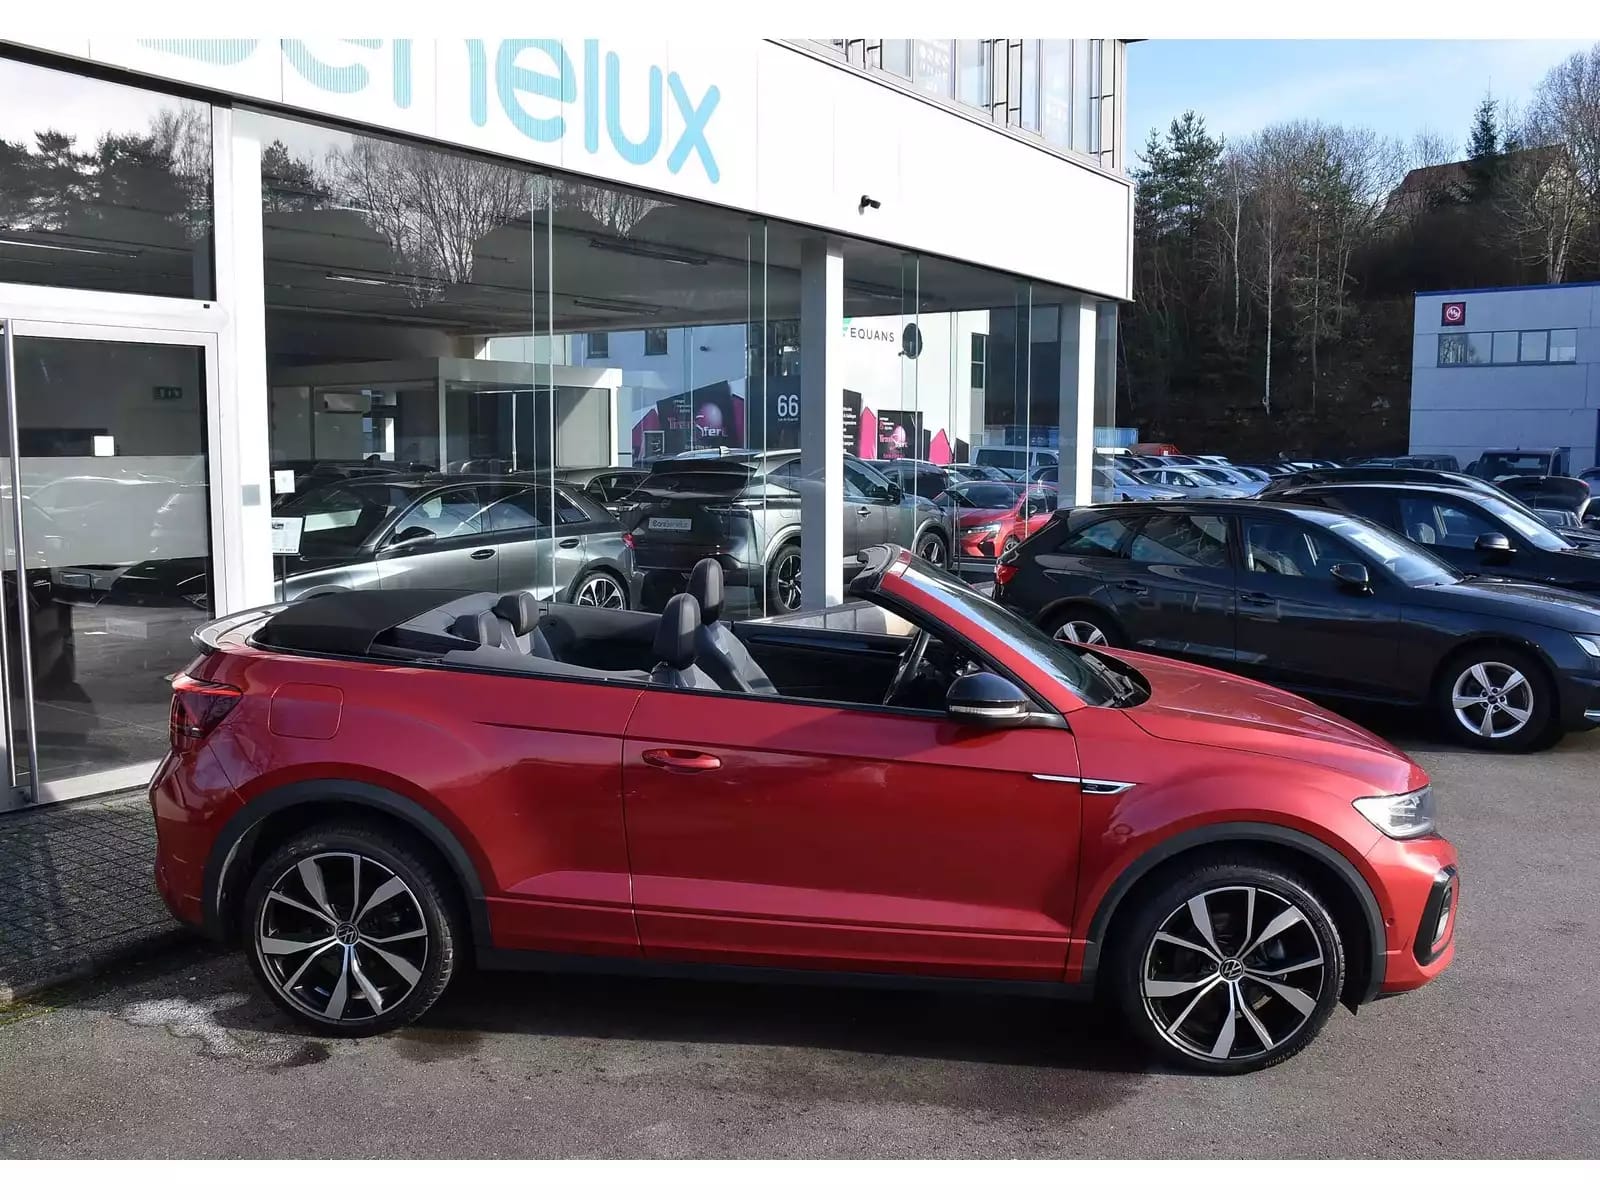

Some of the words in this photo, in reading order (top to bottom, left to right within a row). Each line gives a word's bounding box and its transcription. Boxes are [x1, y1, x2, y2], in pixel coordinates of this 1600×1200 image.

[137, 38, 721, 184] enelux
[850, 327, 895, 343] EQUANS
[777, 394, 799, 417] 66
